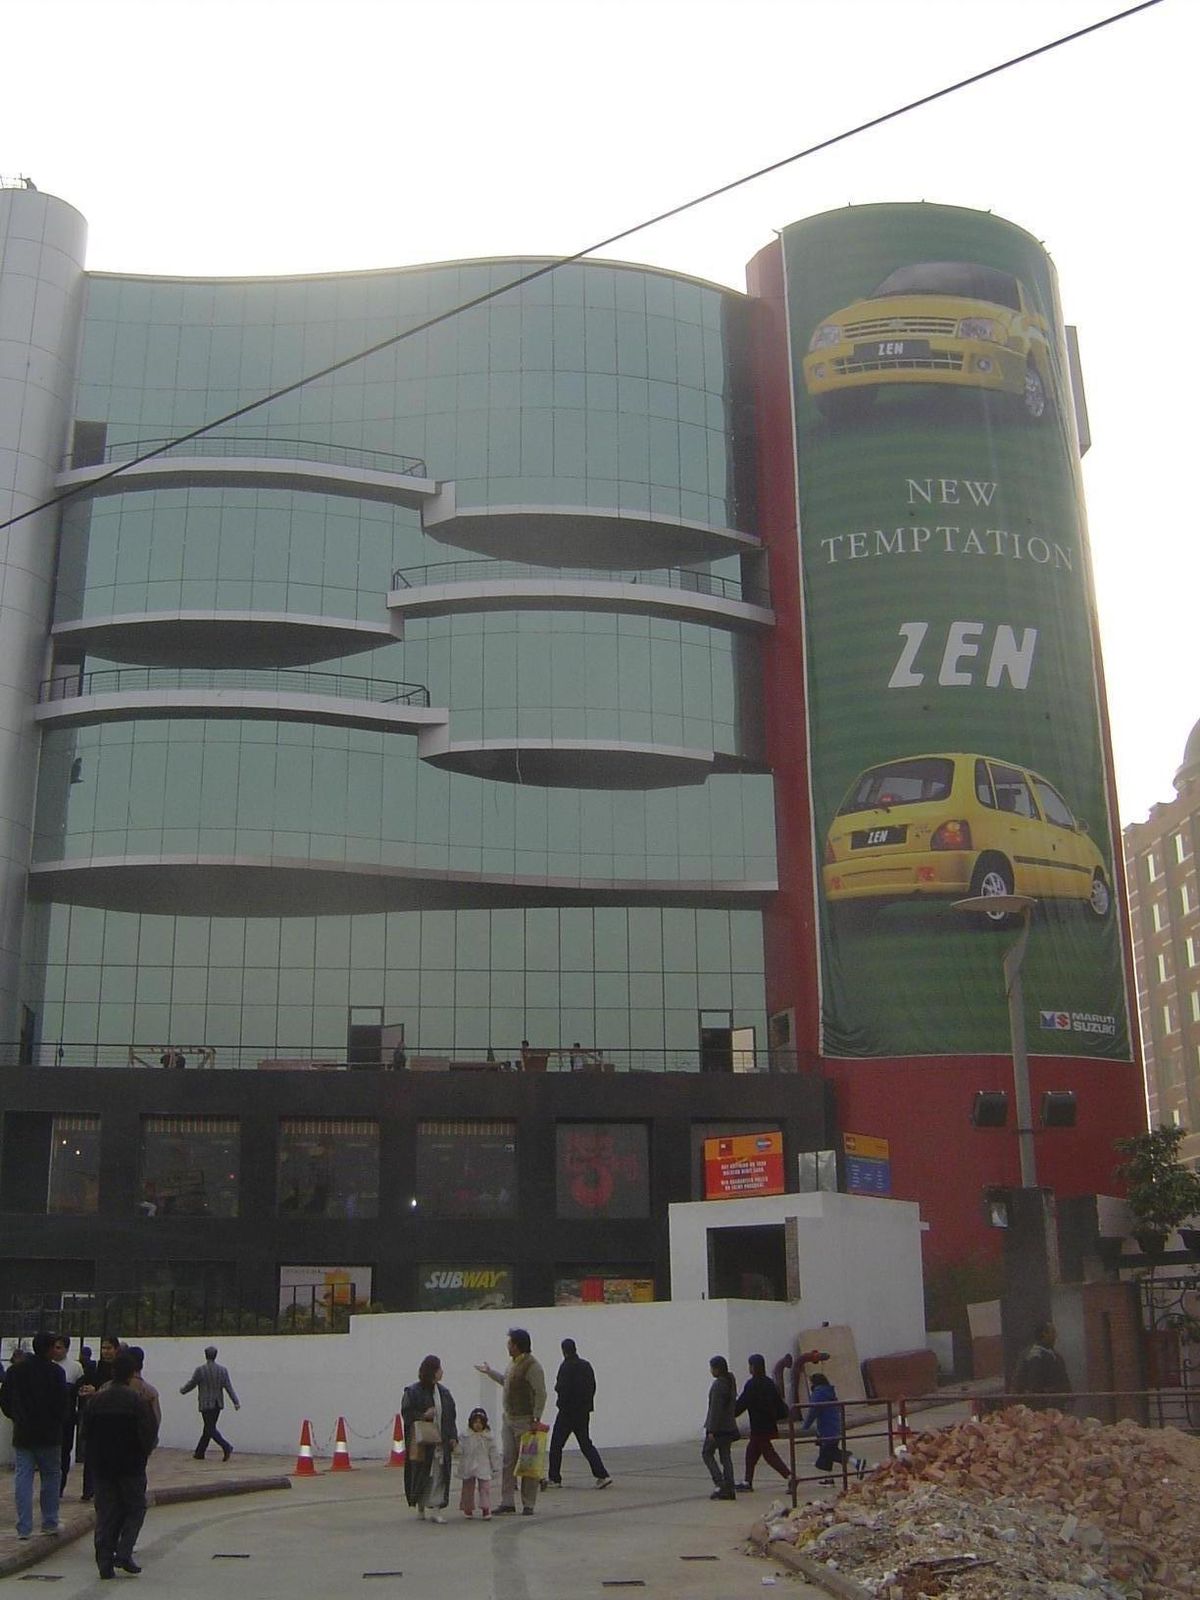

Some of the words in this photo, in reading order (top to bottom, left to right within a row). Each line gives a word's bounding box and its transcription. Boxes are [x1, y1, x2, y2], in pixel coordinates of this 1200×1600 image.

[878, 342, 904, 356] ZEN
[905, 478, 998, 507] NEW
[820, 525, 1073, 572] TEMPTATION
[887, 621, 1038, 690] ZEN
[867, 830, 889, 844] ZEN
[1071, 1012, 1115, 1025] MARUTI
[1072, 1021, 1116, 1036] SUZUKI
[425, 1271, 508, 1289] SUBWAY
